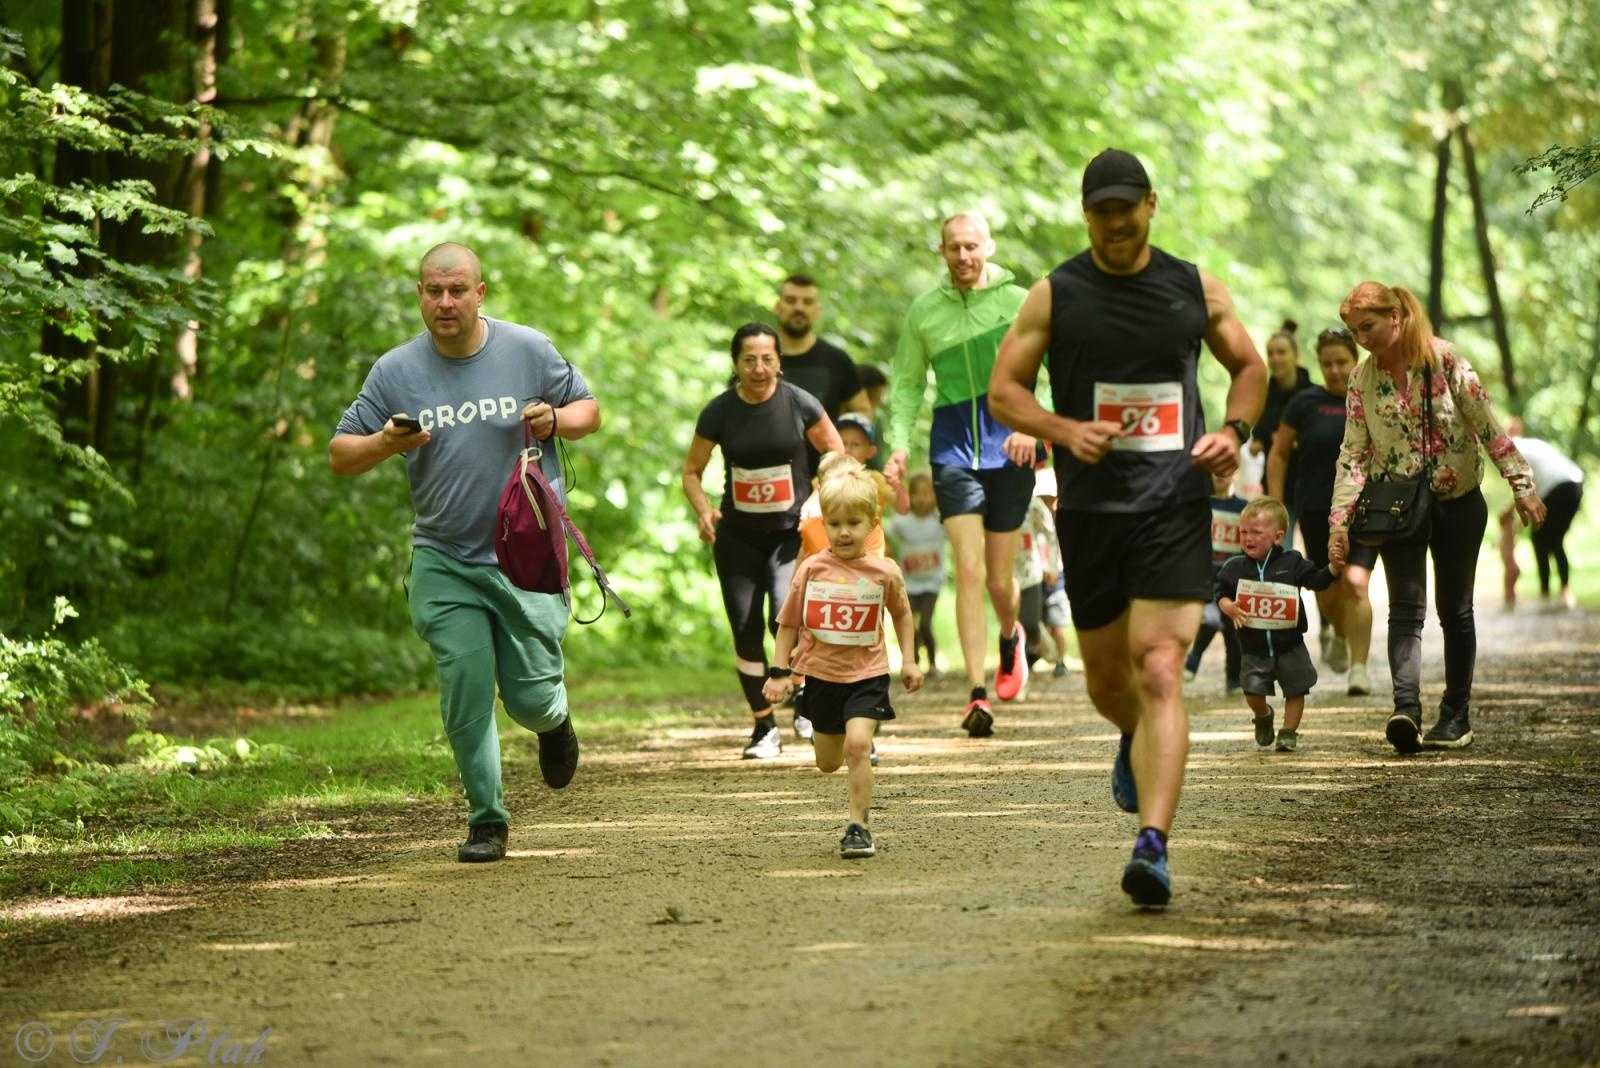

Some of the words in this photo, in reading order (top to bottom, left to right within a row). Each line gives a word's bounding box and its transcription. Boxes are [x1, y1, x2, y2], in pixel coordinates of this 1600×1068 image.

[418, 396, 518, 431] CROPP
[747, 483, 776, 503] 49
[819, 604, 871, 631] 137
[1246, 597, 1287, 619] 182
